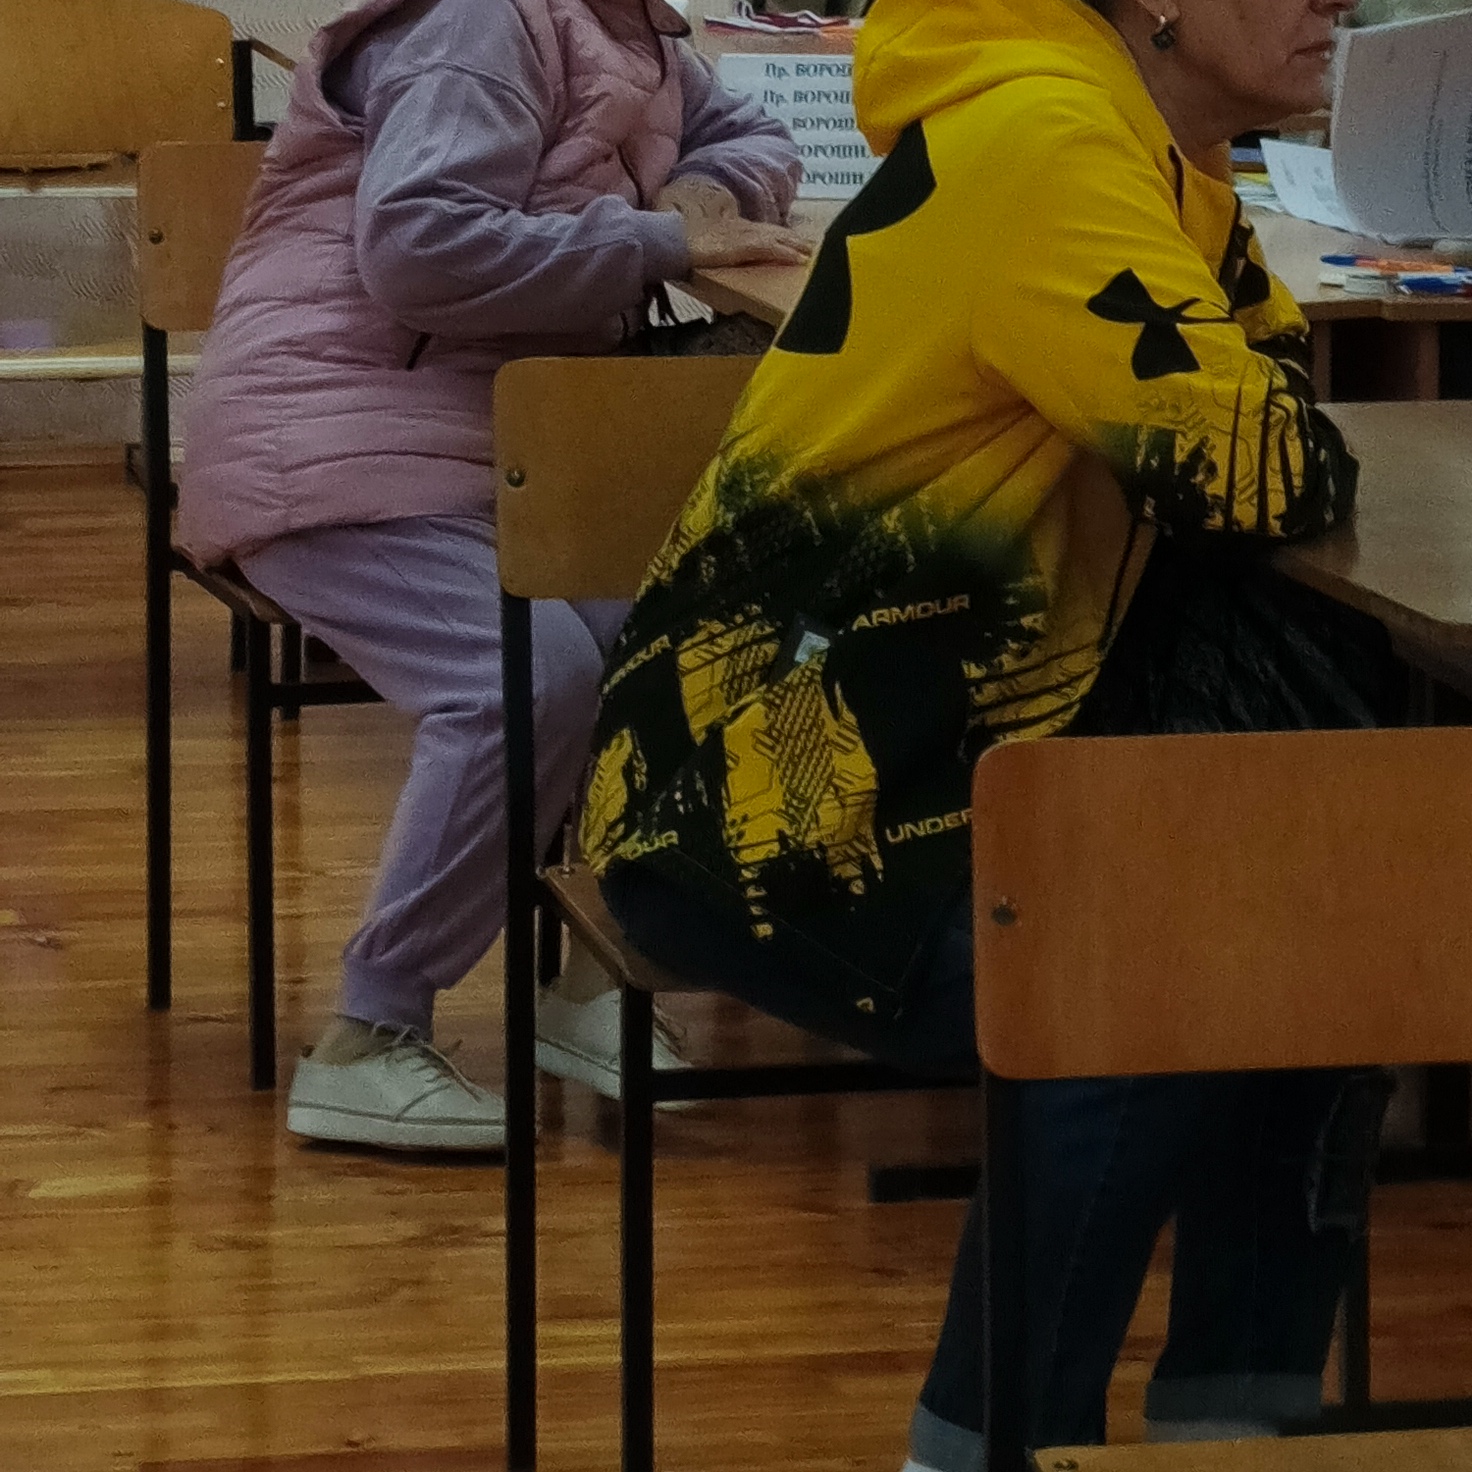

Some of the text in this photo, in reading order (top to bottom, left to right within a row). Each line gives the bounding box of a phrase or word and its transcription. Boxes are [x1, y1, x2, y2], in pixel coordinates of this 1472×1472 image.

[795, 63, 854, 77] ВОРОШ
[793, 90, 852, 104] ВОРОШ
[792, 117, 856, 131] ВОРОШ
[851, 594, 970, 631] ARMOUR
